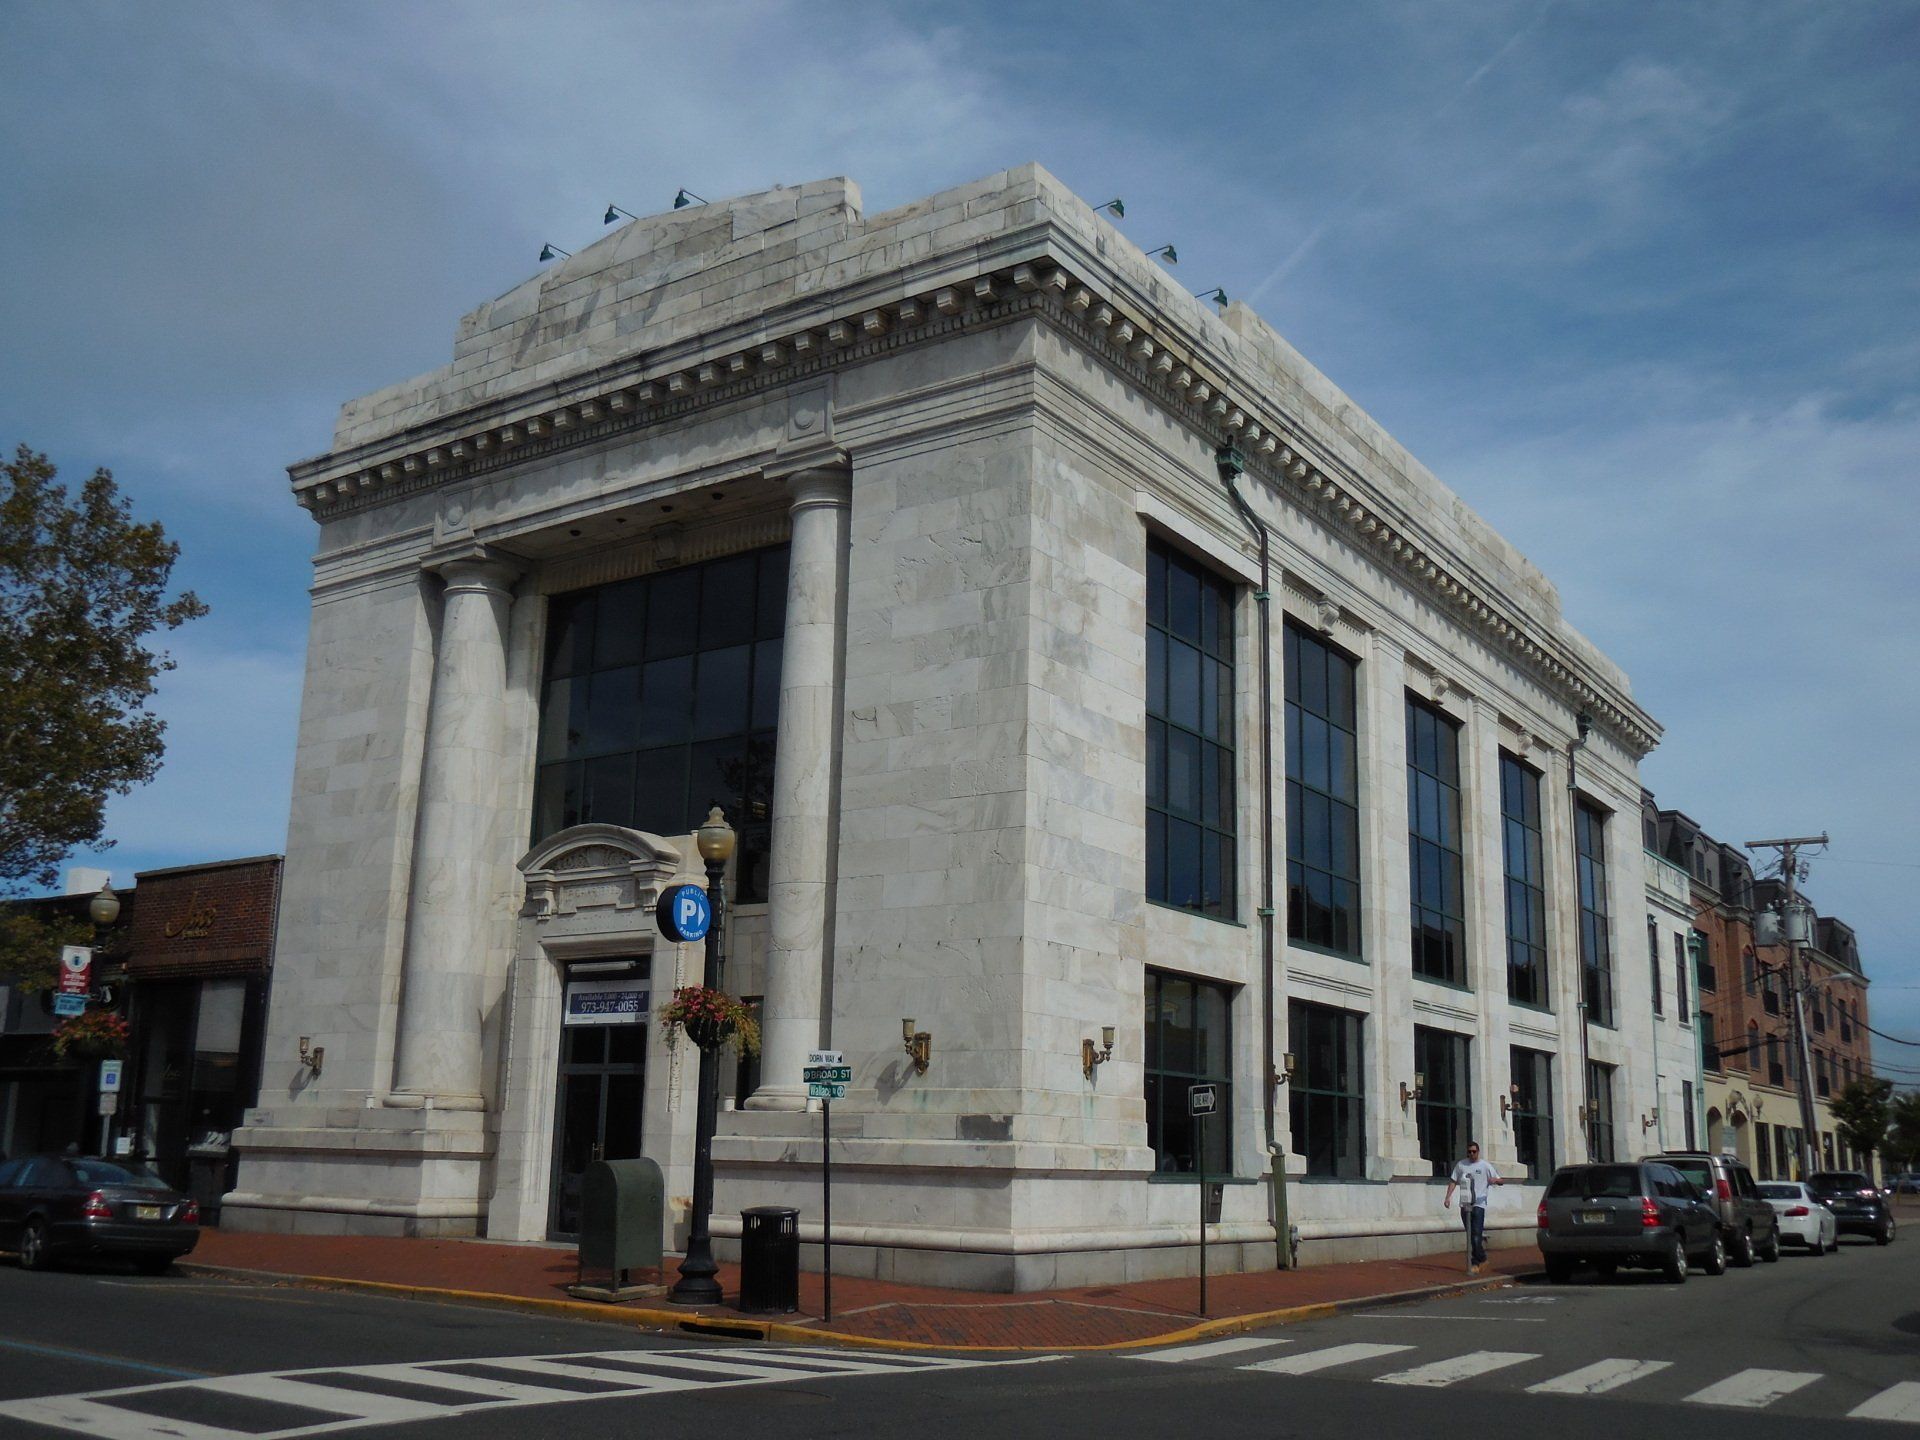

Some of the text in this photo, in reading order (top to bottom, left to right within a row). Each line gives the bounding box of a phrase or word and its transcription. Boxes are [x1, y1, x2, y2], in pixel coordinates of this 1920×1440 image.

[681, 888, 704, 901] PUBLIC
[681, 898, 697, 925] P
[680, 926, 703, 938] PARKING
[581, 1000, 639, 1013] 973-947-0055
[824, 1054, 835, 1063] WAY
[811, 1069, 851, 1079] BROAD ST
